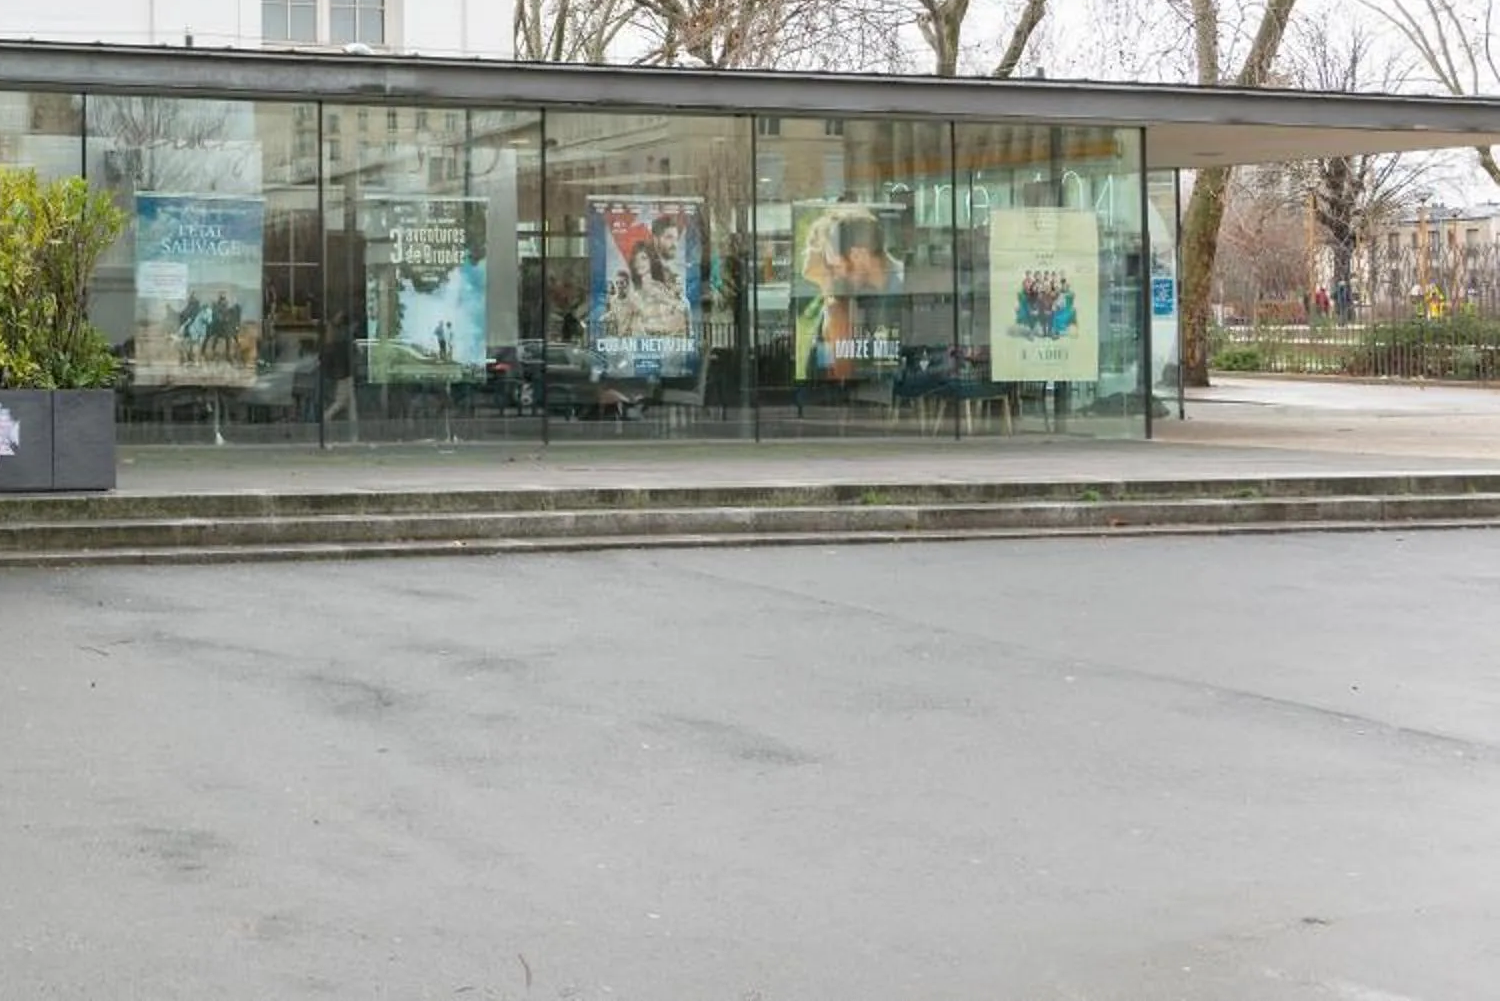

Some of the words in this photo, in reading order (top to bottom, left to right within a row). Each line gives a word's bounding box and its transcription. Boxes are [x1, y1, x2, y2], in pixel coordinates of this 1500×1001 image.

[389, 228, 403, 264] 3
[405, 226, 466, 244] aventures
[404, 244, 421, 264] de
